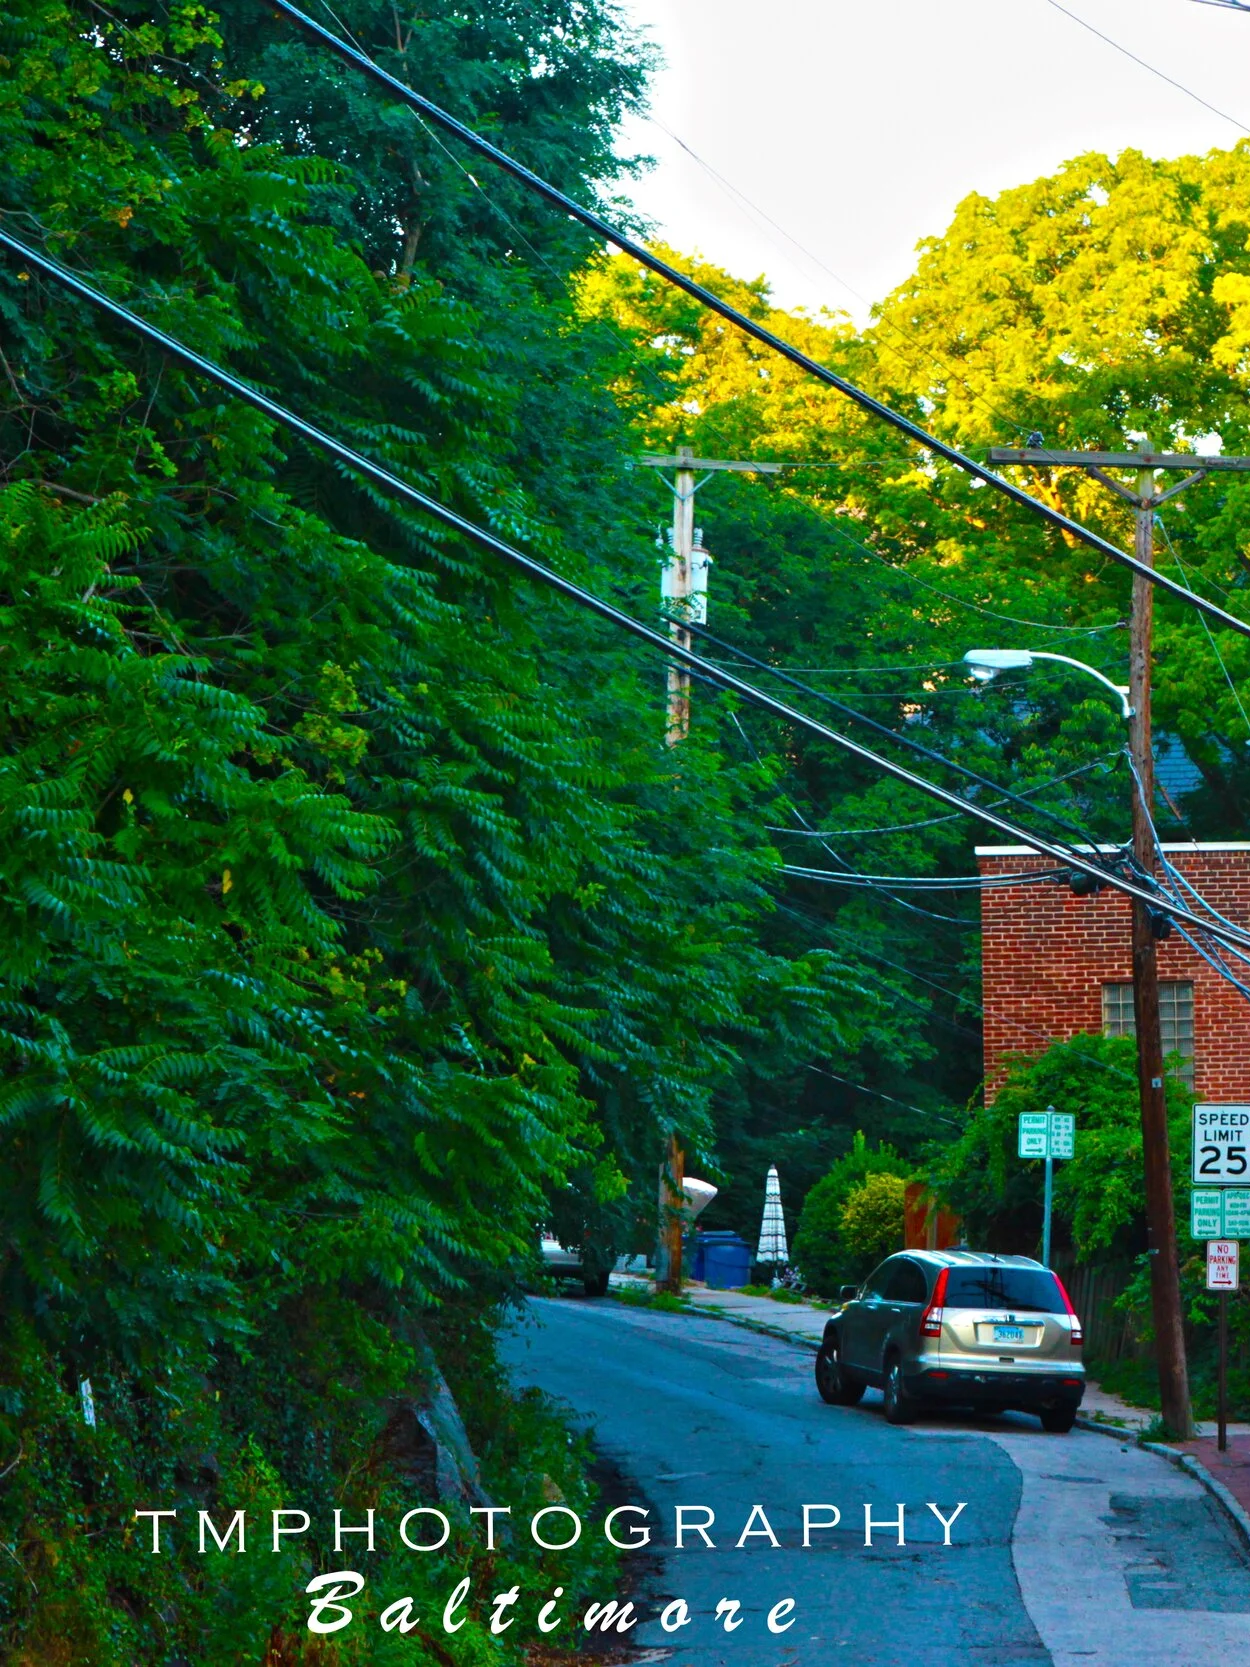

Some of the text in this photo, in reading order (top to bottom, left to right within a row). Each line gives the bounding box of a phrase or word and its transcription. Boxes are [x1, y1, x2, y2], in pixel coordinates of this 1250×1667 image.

[1023, 1116, 1044, 1124] PERMIT
[1199, 1113, 1249, 1125] SPEED
[1204, 1130, 1243, 1142] LIMIT
[1027, 1137, 1041, 1145] ONLY
[1199, 1146, 1248, 1175] 25
[1195, 1196, 1219, 1204] PERMIT
[1195, 1208, 1220, 1216] PARKING
[1197, 1219, 1217, 1227] ONLY
[1217, 1245, 1229, 1254] NO
[1209, 1255, 1236, 1264] PARKING
